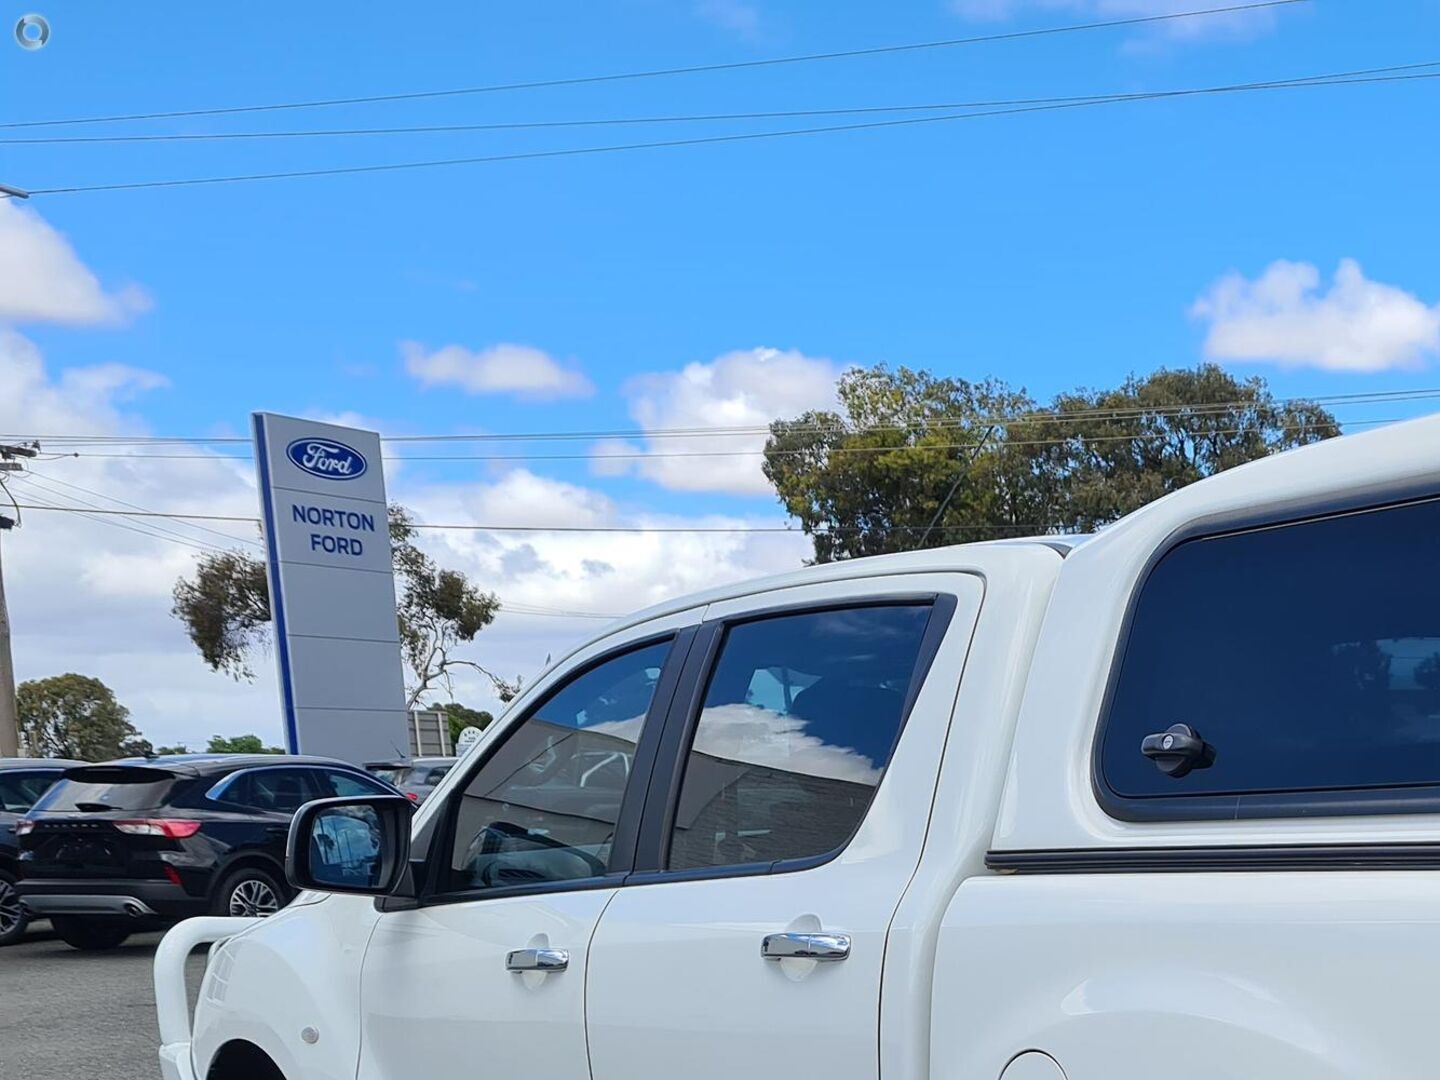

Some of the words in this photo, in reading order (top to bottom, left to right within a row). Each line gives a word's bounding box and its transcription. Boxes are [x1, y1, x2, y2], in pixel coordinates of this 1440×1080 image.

[302, 442, 353, 475] Ford
[292, 504, 375, 532] NORTON
[310, 534, 363, 556] FORD
